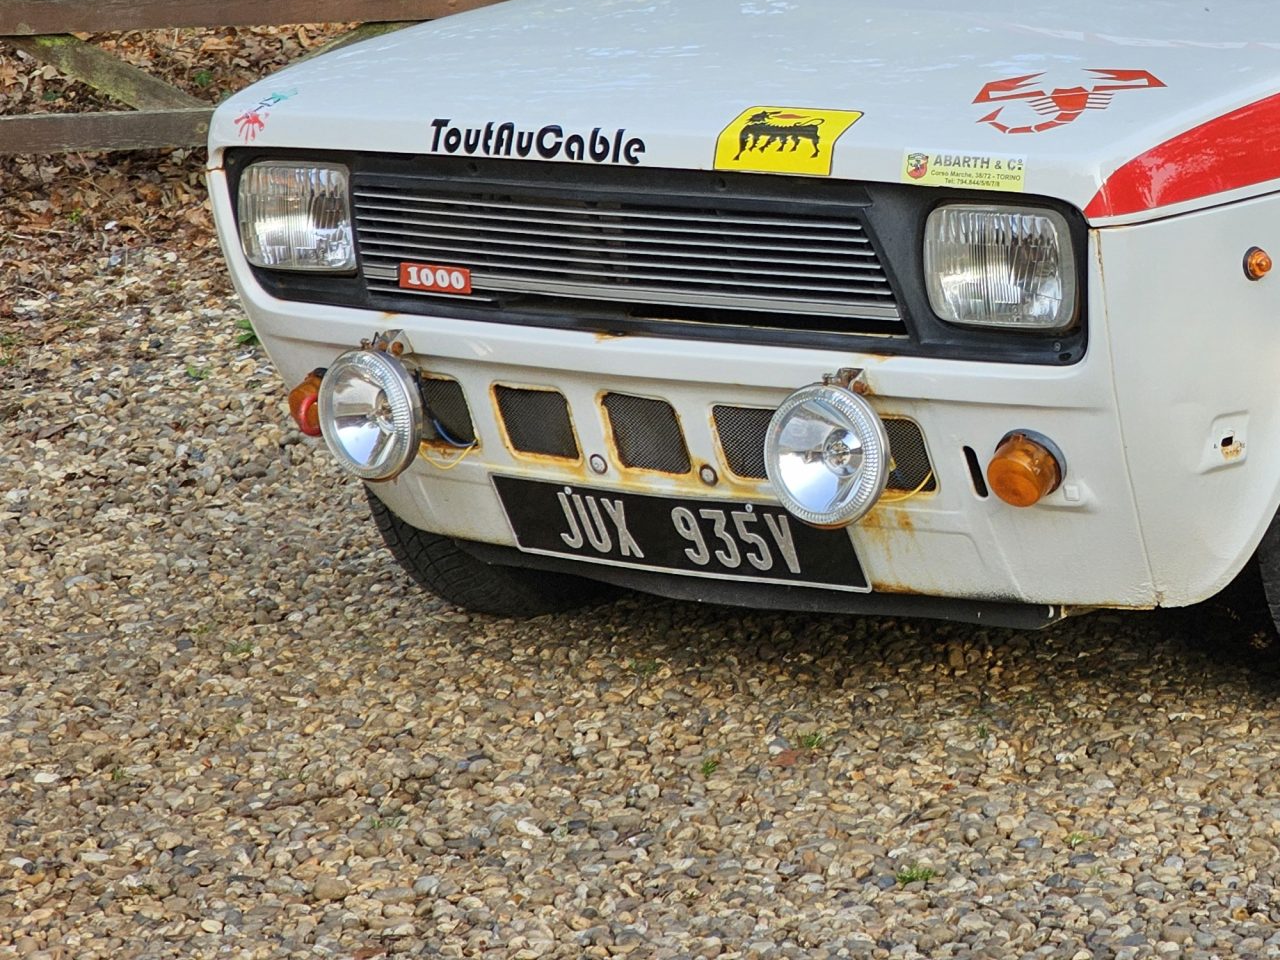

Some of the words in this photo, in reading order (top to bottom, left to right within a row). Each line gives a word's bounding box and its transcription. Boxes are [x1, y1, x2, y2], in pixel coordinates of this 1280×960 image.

[430, 118, 646, 165] ToutAuCable
[933, 154, 990, 169] ABARTH
[994, 159, 1002, 170] &
[930, 169, 949, 177] Corso
[997, 173, 1021, 182] TORINO
[407, 266, 465, 290] 1000
[557, 492, 645, 559] JUX
[670, 506, 801, 574] 935V
